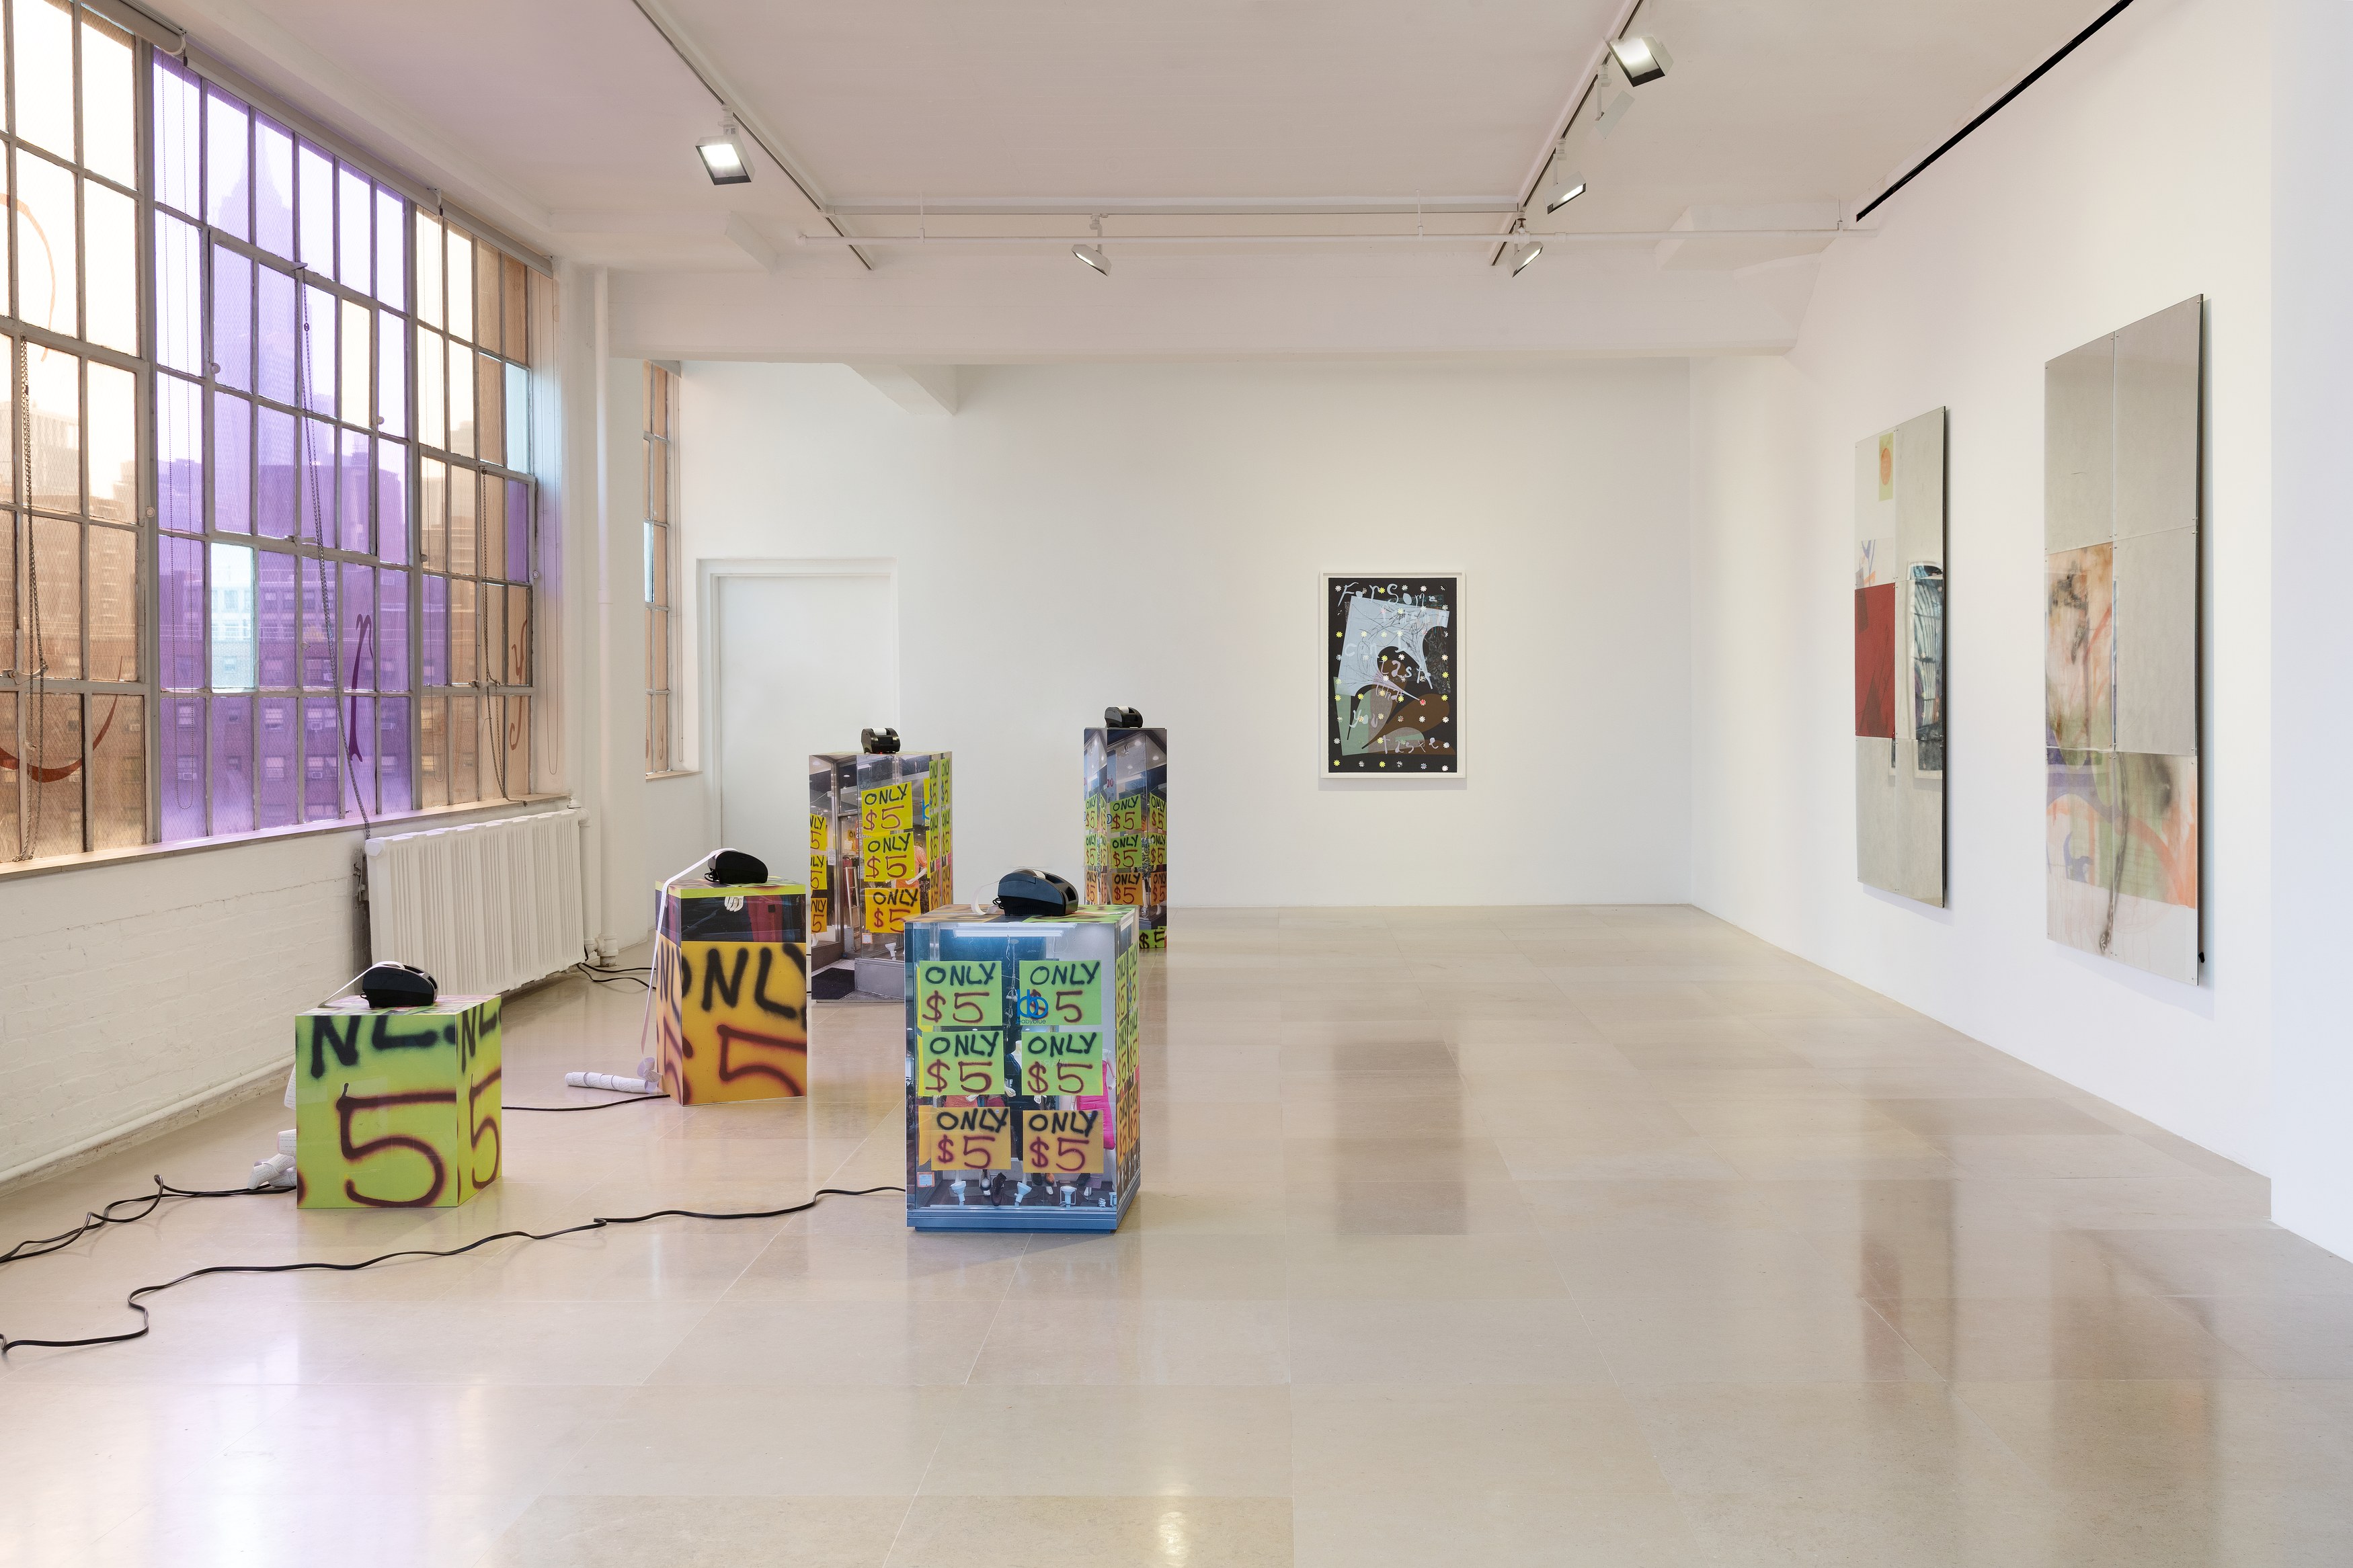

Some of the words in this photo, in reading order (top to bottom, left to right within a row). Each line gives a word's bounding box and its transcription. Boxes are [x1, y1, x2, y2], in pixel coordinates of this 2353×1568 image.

[865, 784, 908, 805] ONLY
[1113, 796, 1139, 811] ONLY
[868, 833, 910, 854] ONLY
[1112, 835, 1138, 848] ONLY
[1150, 835, 1166, 845] ONLY
[1114, 872, 1140, 885] ONLY
[873, 889, 918, 907] ONLY
[925, 962, 996, 986] ONLY
[1030, 962, 1100, 985] ONLY
[930, 1032, 999, 1057] ONLY
[1028, 1032, 1096, 1058] ONLY
[936, 1108, 1008, 1133] ONLY
[1029, 1110, 1099, 1137] ONLY
